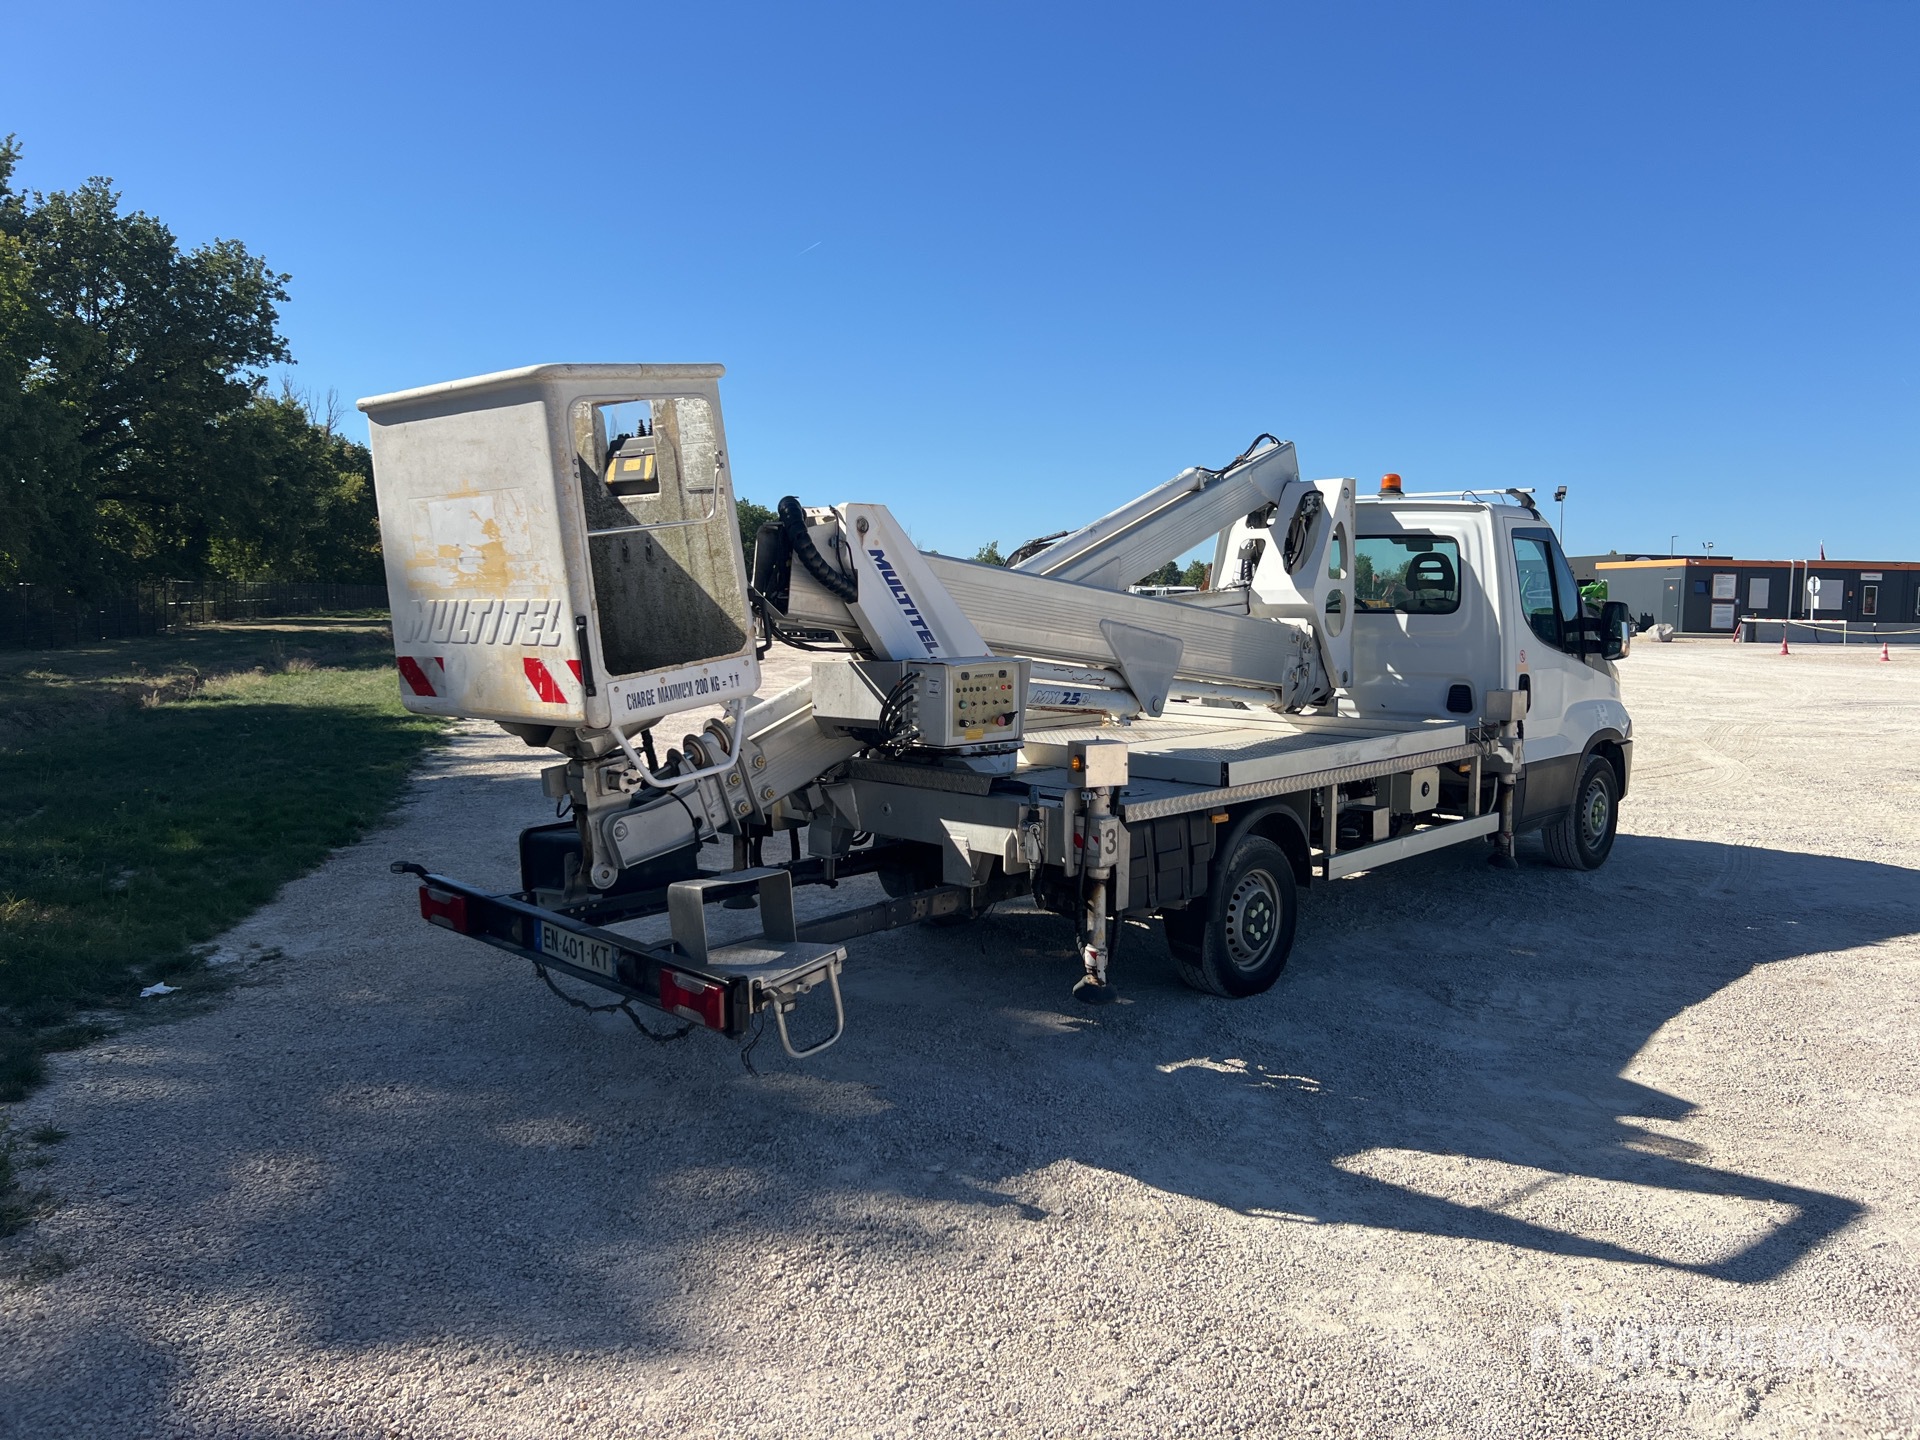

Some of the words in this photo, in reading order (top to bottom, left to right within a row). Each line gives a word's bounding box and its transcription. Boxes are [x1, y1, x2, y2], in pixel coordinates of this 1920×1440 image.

[867, 549, 939, 654] MULTITEL
[402, 599, 562, 647] MULTITEL
[626, 689, 656, 711] CHARGE
[657, 681, 694, 704] MAXIMUM
[695, 678, 709, 695] 200
[710, 676, 721, 692] KG
[1030, 690, 1060, 704] MX
[1514, 745, 1521, 763] 4
[1105, 828, 1117, 855] 3
